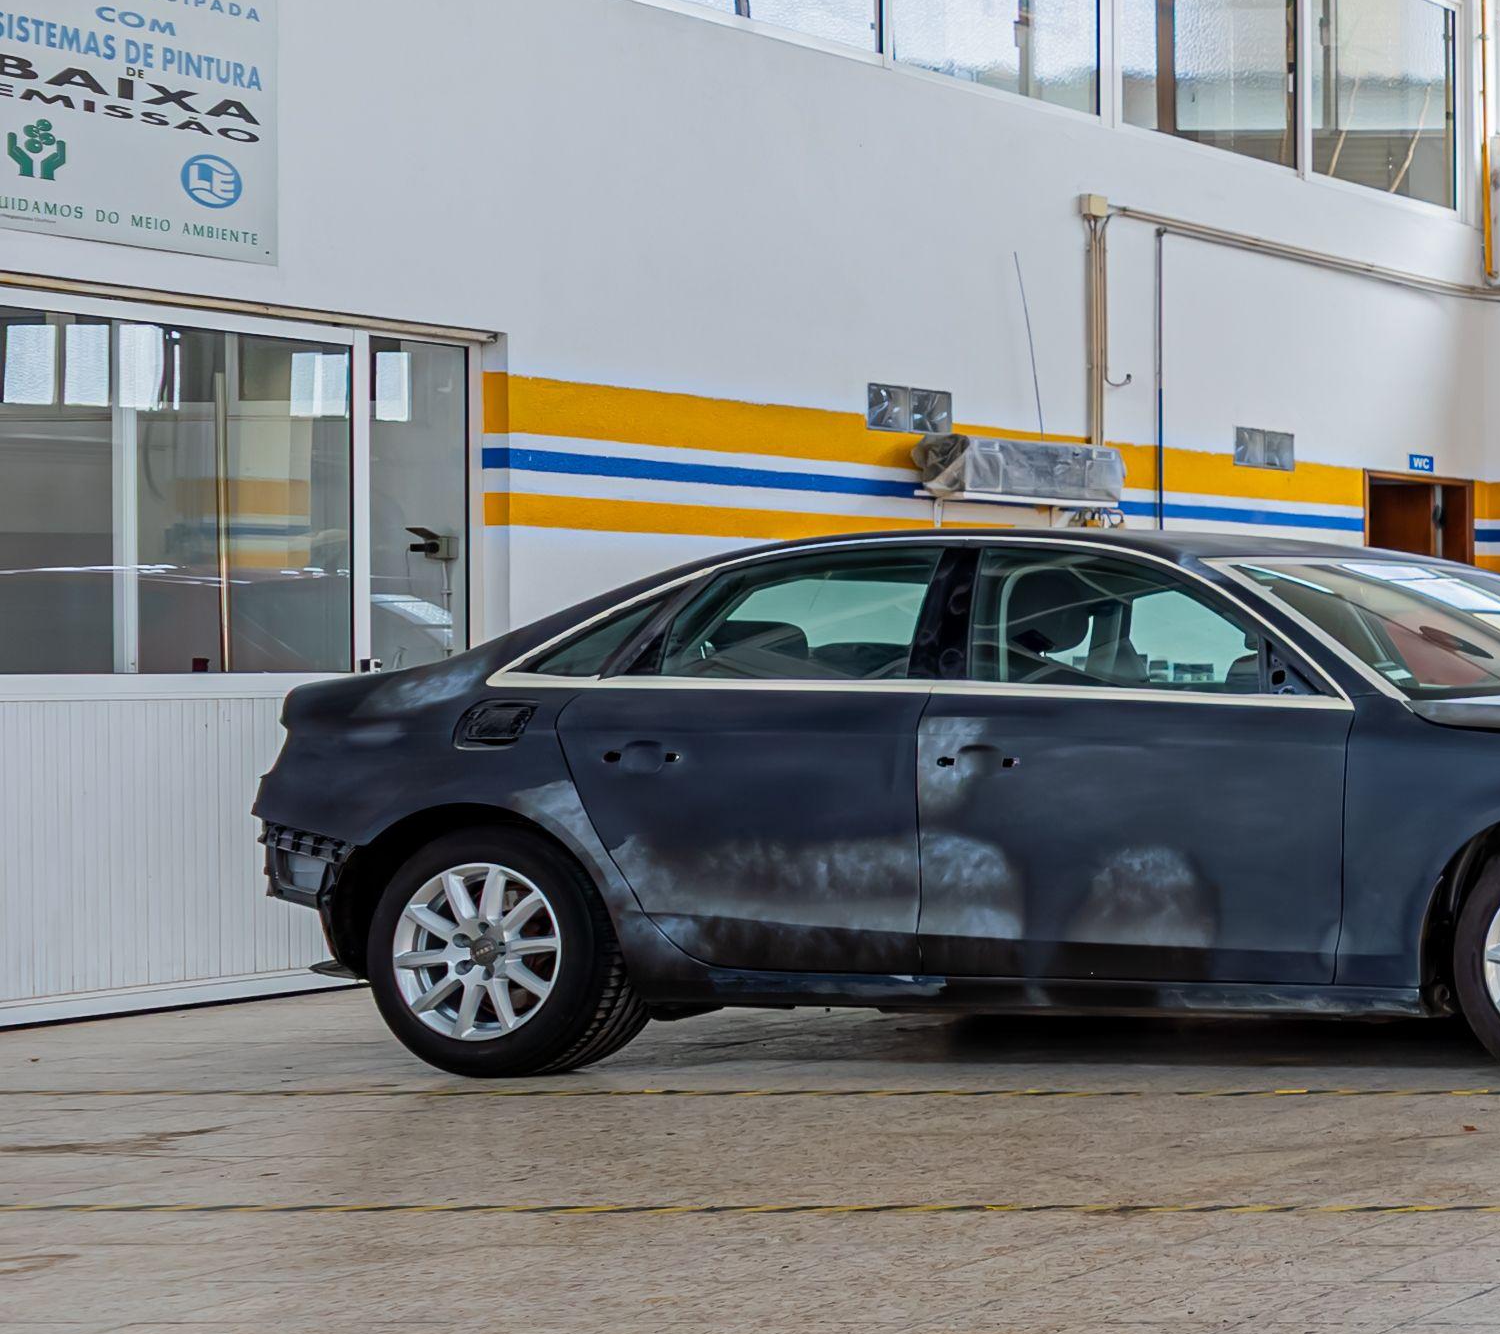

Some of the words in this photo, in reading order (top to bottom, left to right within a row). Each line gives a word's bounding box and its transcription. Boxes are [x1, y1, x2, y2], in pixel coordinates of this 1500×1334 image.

[95, 6, 177, 37] COM
[125, 38, 153, 68] DE
[162, 46, 262, 91] PINTURA
[126, 66, 144, 79] DE
[0, 53, 260, 126] BAIXA
[95, 209, 120, 225] DO
[131, 215, 171, 232] MEIO
[182, 222, 258, 246] AMBIENTE
[1413, 457, 1430, 469] WC
